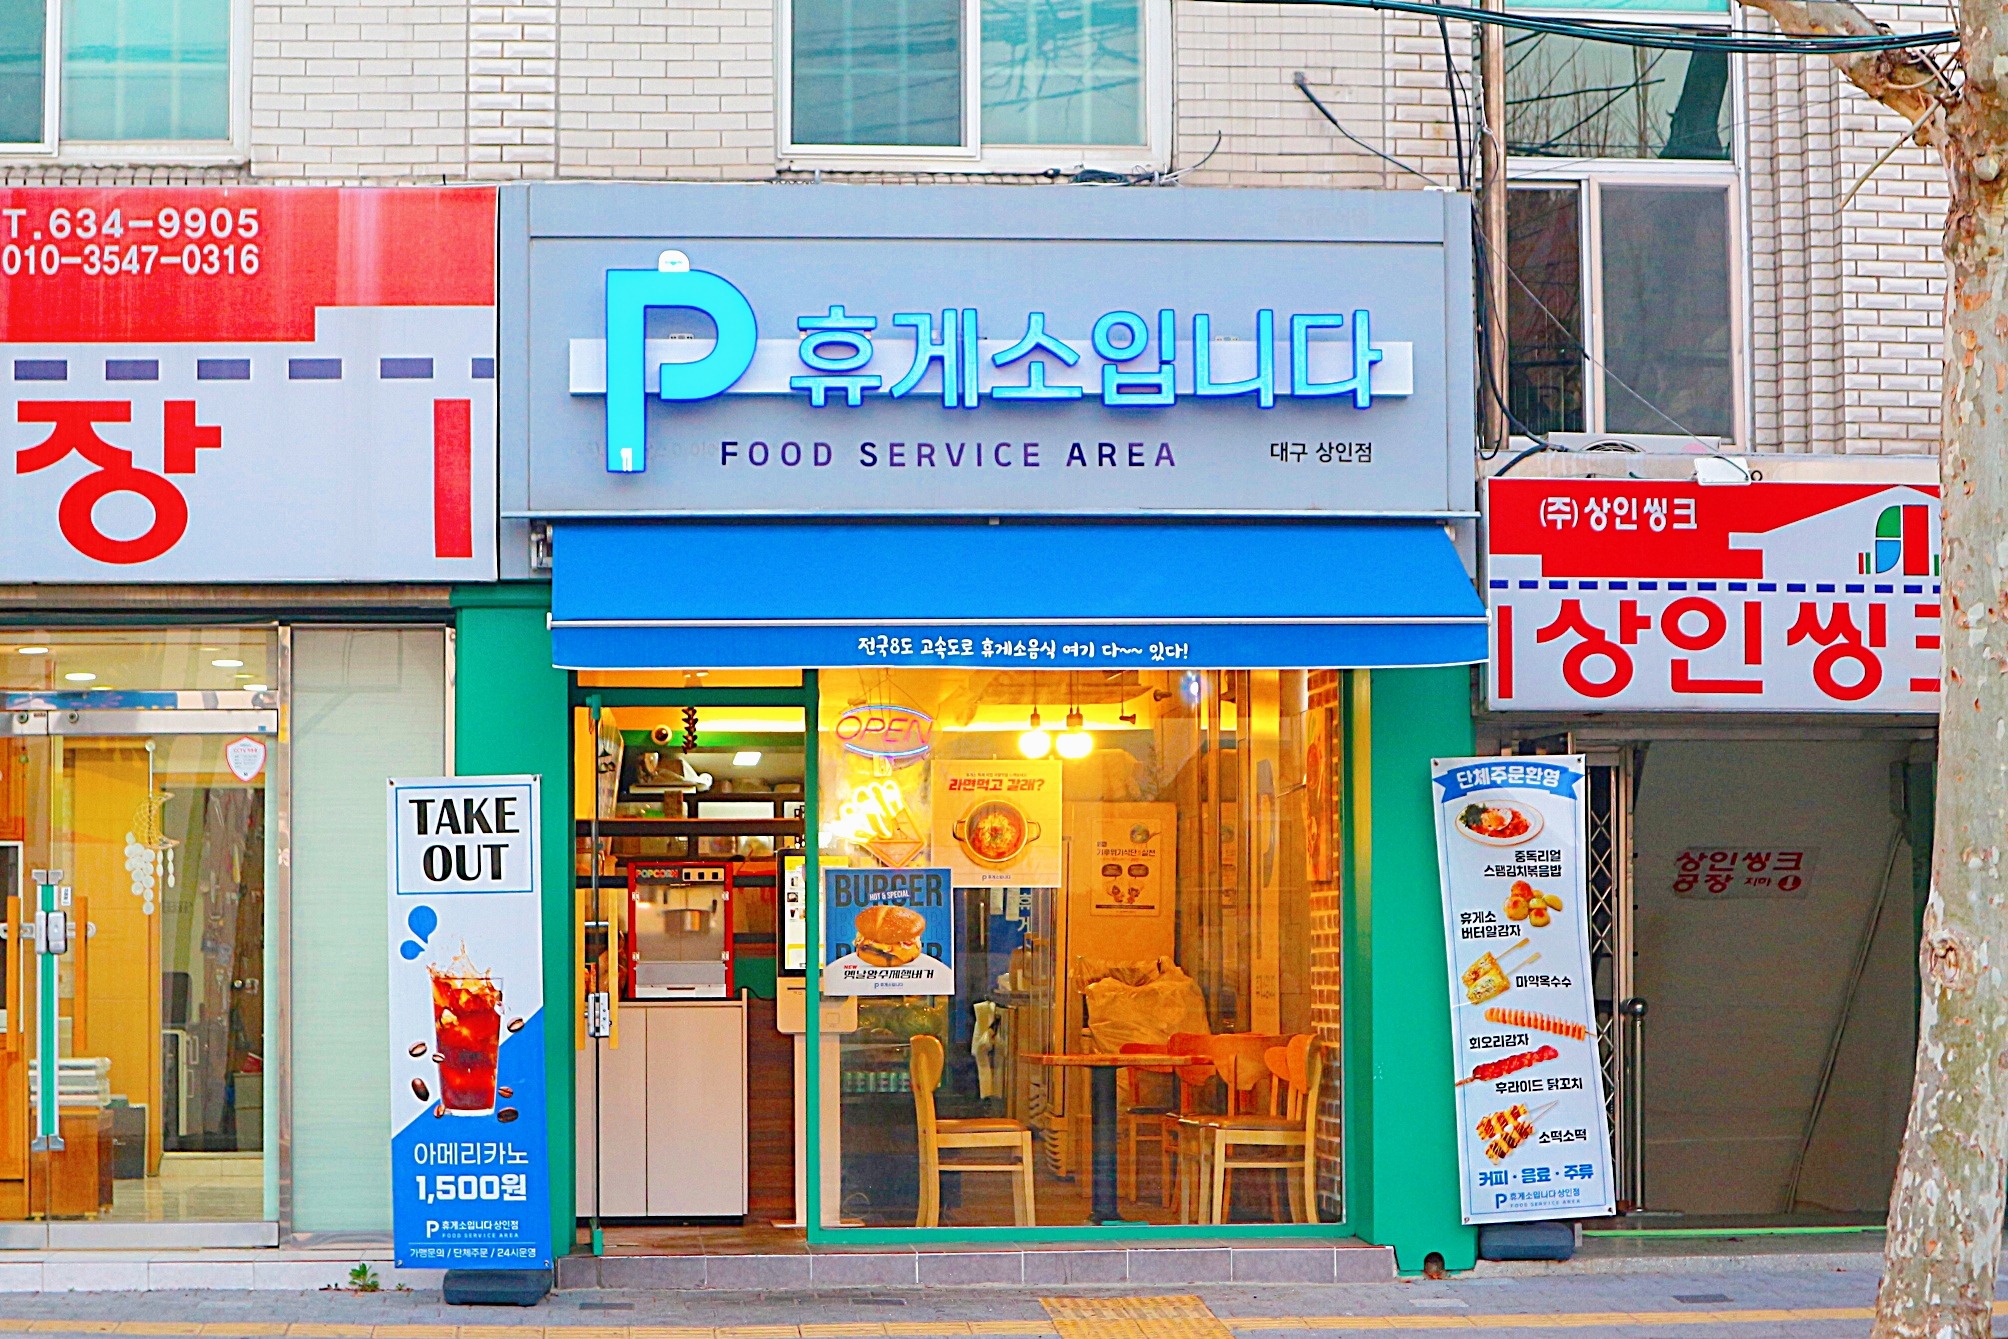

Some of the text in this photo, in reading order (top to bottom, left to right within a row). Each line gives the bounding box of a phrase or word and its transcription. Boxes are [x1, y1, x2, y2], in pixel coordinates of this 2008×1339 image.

[2, 207, 260, 240] T.634-9905
[2, 244, 260, 275] 010-3547-0316
[789, 304, 1383, 410] 휴게소입니다
[605, 268, 759, 474] P
[721, 441, 1176, 468] FOOD SERVICE AREA
[1270, 442, 1373, 463] 대구 상인점
[857, 635, 912, 658] 전국8도
[920, 635, 974, 659] 고속도로
[981, 639, 1056, 661] 휴게소음식
[1062, 641, 1095, 659] 여기
[1149, 641, 1188, 662] 있다!
[835, 715, 934, 744] OPEN
[949, 779, 1003, 791] 라면먹고
[1457, 765, 1561, 790] 단체주문환영
[409, 797, 520, 835] TAKE
[423, 843, 509, 881] OUT
[1515, 849, 1562, 863] 중독리얼
[1675, 852, 1803, 872] 상인씽크
[636, 869, 679, 878] POPCORN
[1484, 865, 1562, 878] 스팸김치볶음밥
[869, 892, 881, 901] HOT
[887, 889, 910, 900] SPECIAL
[1460, 910, 1497, 925] 휴게소
[1461, 924, 1521, 940] 버터알감자
[1516, 975, 1572, 988] 마약옥수수
[1469, 1033, 1530, 1050] 회오리감자
[1495, 1077, 1583, 1094] 후라이드 닭꼬치
[1539, 1129, 1587, 1144] 소떡소떡
[414, 1142, 529, 1166] 아메리카노
[1478, 1163, 1594, 1187] 커피 음료 주류
[416, 1173, 527, 1205] 1,500원
[1510, 1190, 1556, 1201] 휴게소입니다
[442, 1220, 519, 1231] 휴게소입니다 상인점
